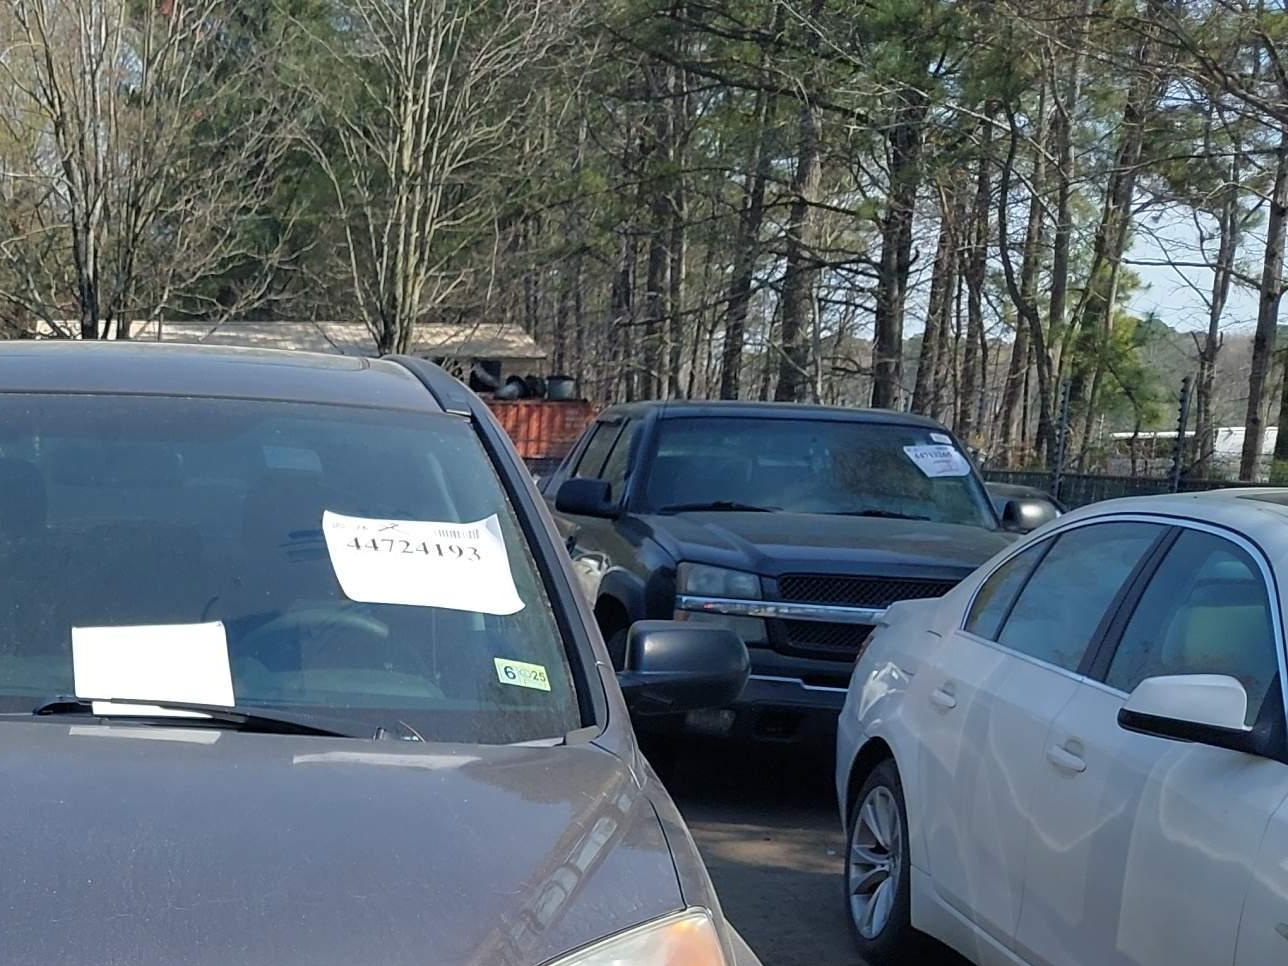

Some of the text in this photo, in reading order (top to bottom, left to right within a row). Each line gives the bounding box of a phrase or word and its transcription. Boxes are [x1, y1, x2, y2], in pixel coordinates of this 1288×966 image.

[346, 536, 481, 561] 44724193
[503, 665, 547, 682] 6 25
